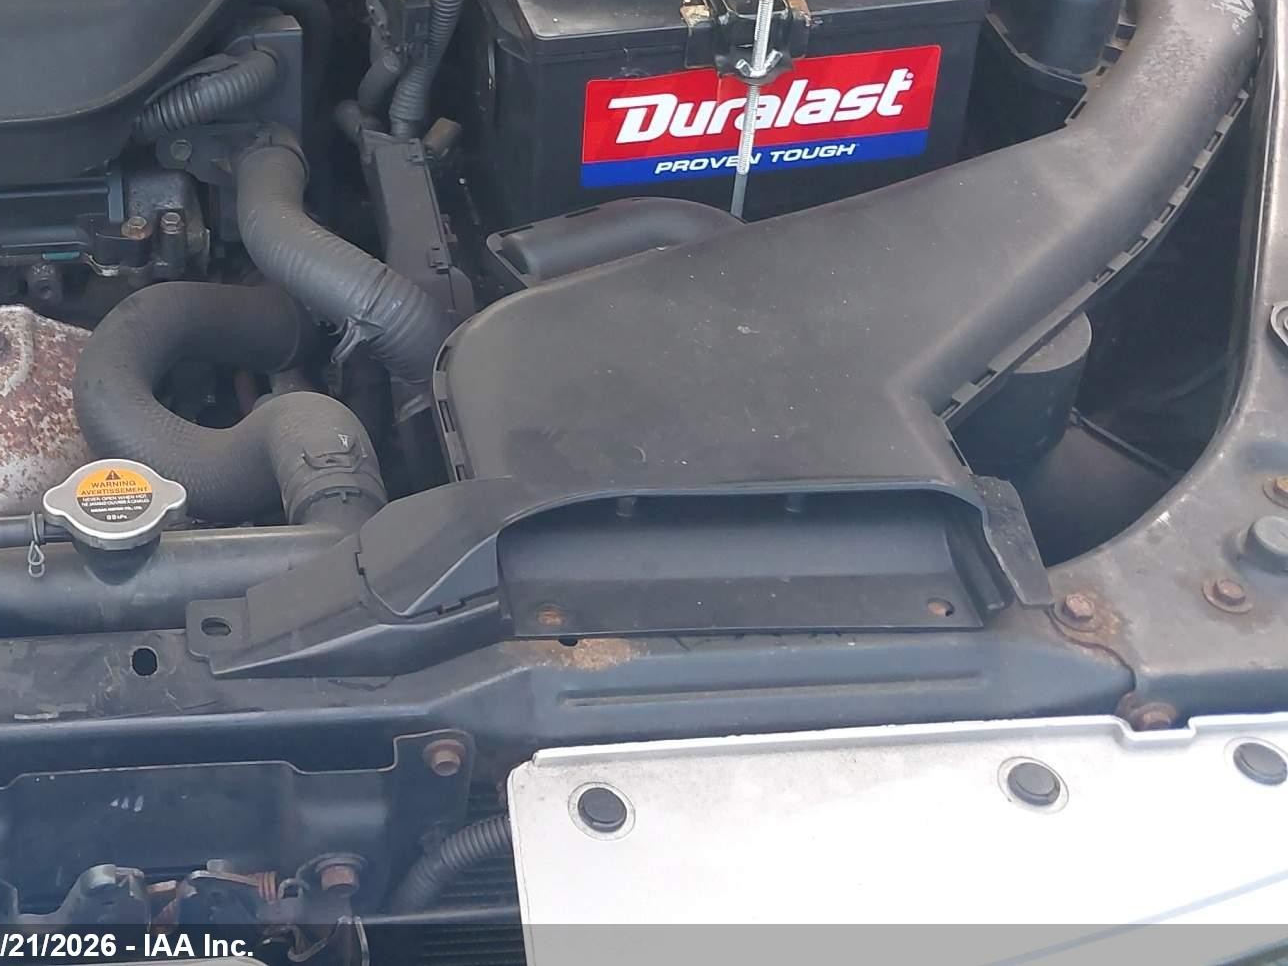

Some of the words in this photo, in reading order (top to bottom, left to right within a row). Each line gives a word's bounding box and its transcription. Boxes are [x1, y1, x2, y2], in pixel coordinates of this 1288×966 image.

[608, 67, 912, 144] Duralast
[770, 143, 856, 164] TOUGH
[81, 486, 149, 495] AVERTISSEMENT
[91, 480, 137, 488] WARNING
